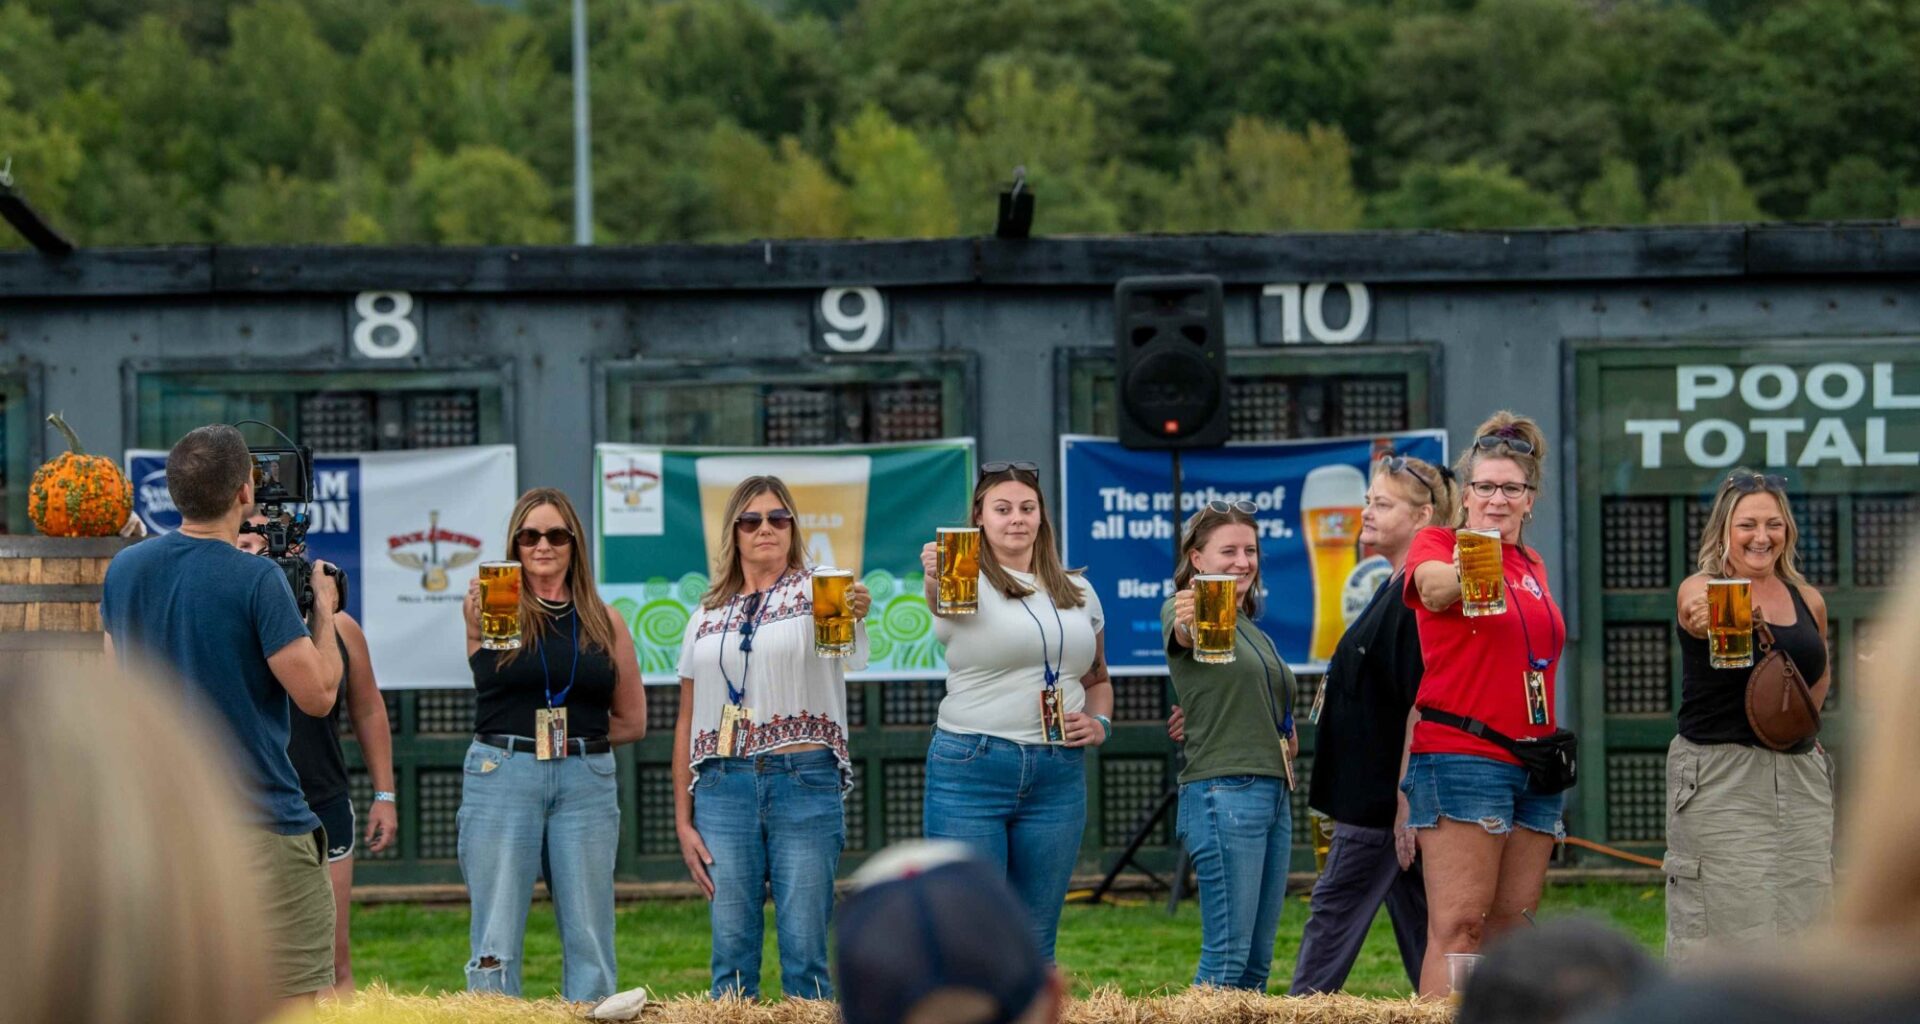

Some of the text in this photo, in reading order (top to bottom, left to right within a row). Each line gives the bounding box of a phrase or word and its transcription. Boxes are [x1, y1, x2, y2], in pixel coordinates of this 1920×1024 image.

[352, 290, 418, 359] 8
[820, 286, 886, 353] 9
[1262, 282, 1371, 344] 10
[1676, 362, 1920, 412] POOL
[1624, 417, 1920, 469] TOTAL
[1099, 487, 1149, 512] The
[1255, 486, 1287, 511] of
[1091, 514, 1124, 539] all
[1118, 578, 1162, 599] Bier
